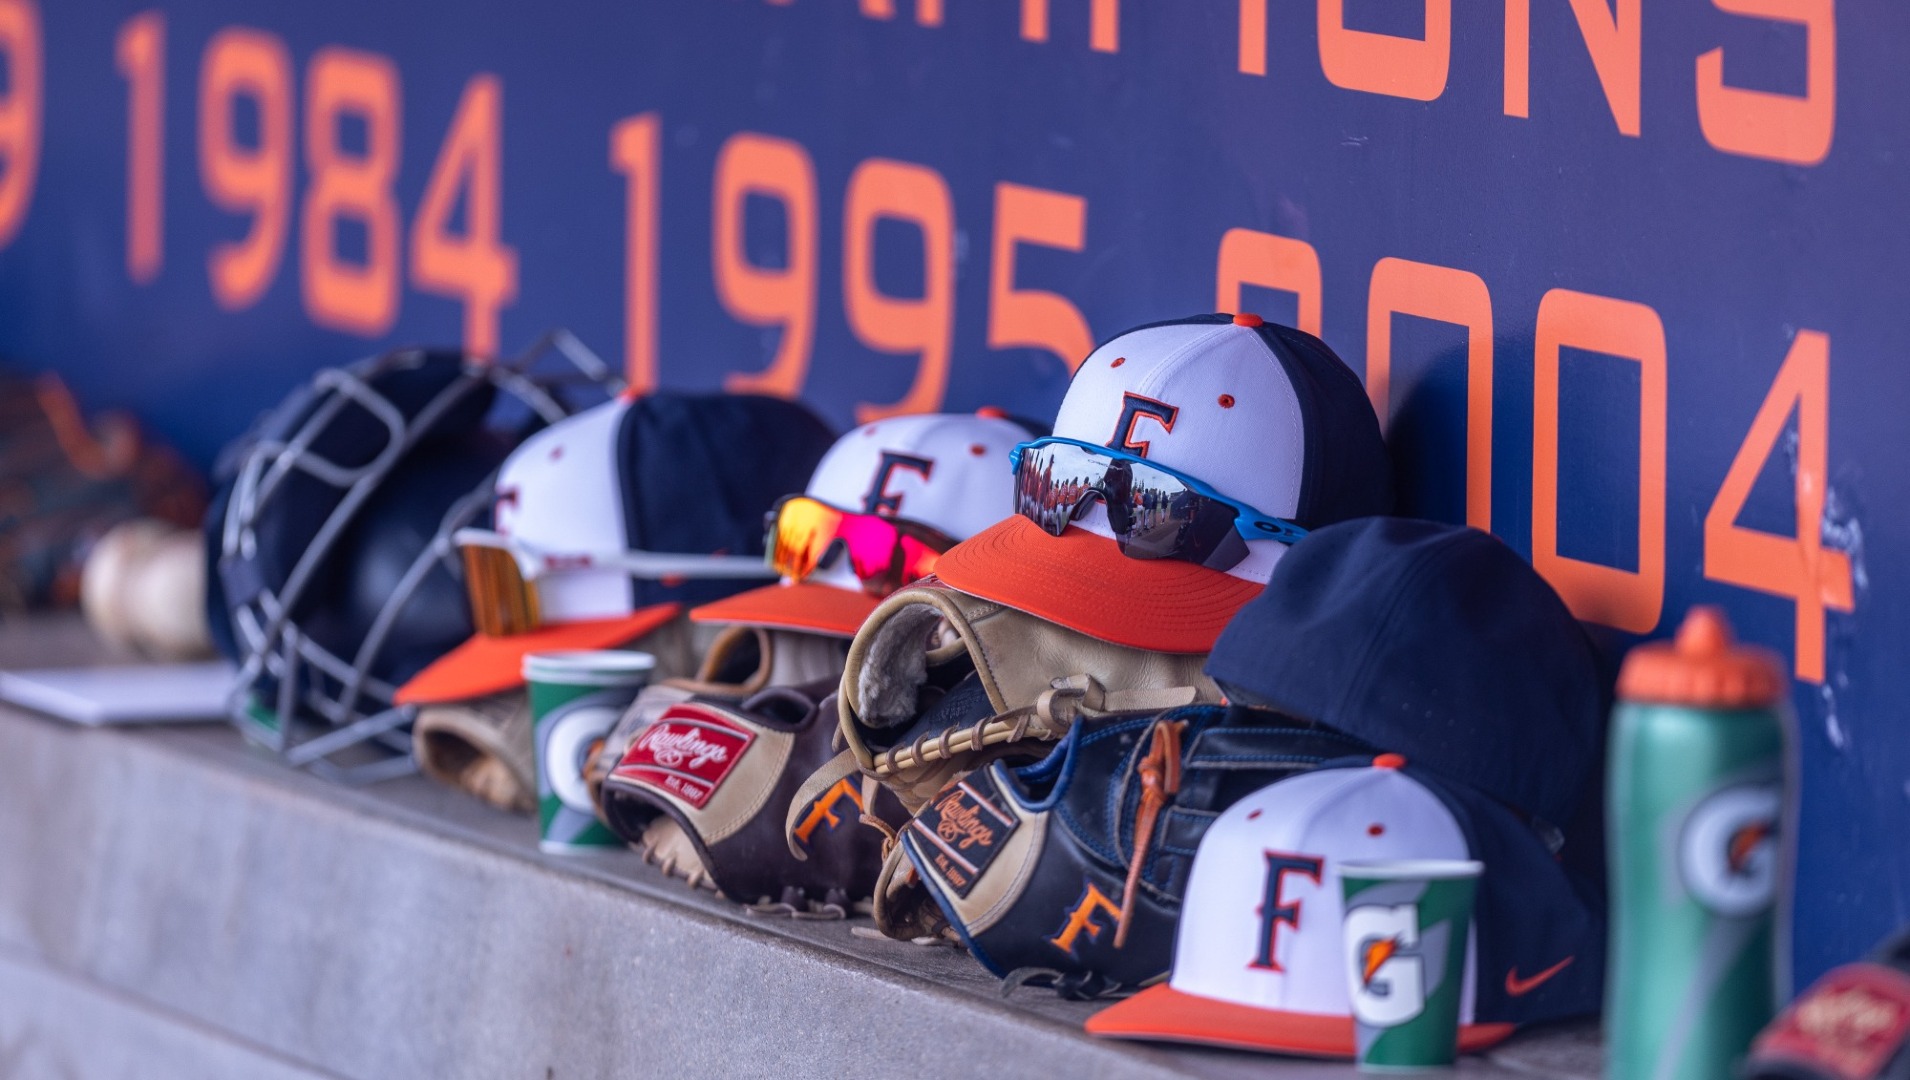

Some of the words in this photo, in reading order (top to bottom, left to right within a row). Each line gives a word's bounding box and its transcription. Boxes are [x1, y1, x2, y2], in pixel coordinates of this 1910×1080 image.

[117, 12, 518, 366] 1984
[610, 112, 1096, 424] 1995
[1104, 390, 1180, 460] F
[862, 449, 935, 516] F
[638, 722, 729, 770] Rawlings
[935, 789, 993, 850] Rawlings
[1045, 880, 1124, 956] F
[1246, 848, 1326, 974] F
[1344, 903, 1425, 1029] G
